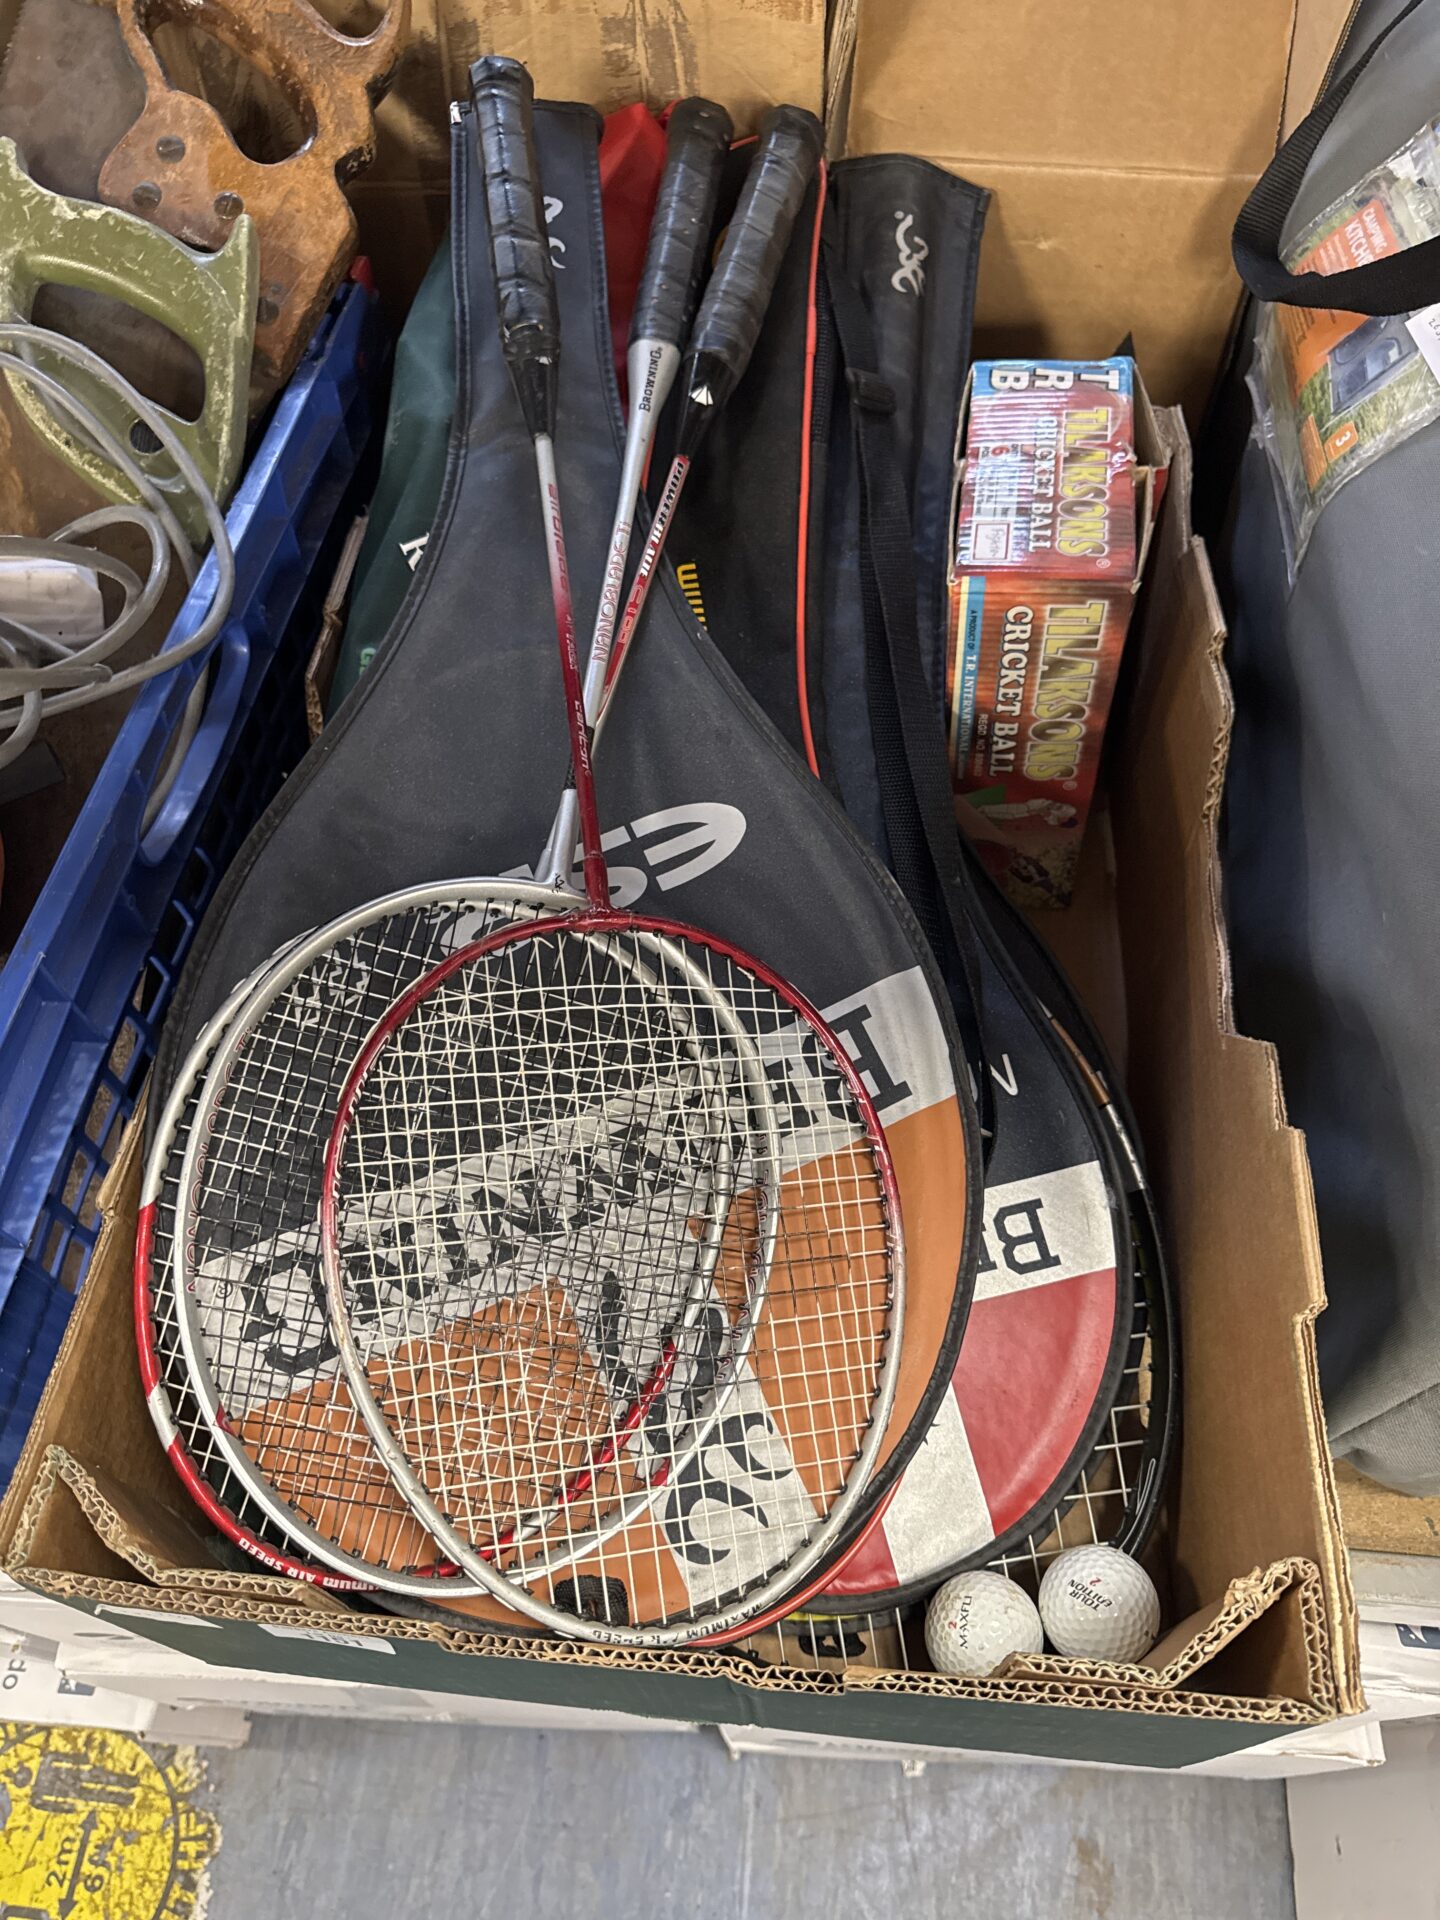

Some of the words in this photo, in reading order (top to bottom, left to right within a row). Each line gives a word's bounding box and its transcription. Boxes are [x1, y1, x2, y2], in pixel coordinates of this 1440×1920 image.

[1034, 416, 1058, 498] CRICKET
[1335, 431, 1351, 447] 3
[1057, 407, 1111, 557] TILAKSONS
[1028, 502, 1053, 553] BALL
[592, 541, 628, 664] NANOBLADE
[995, 605, 1034, 717] CRICKET
[957, 676, 976, 755] INTERNATIONAL
[1024, 599, 1109, 781] TILAKSONS
[988, 721, 1020, 777] BALL
[238, 1537, 284, 1572] SPEED
[287, 1567, 317, 1583] AIR
[1067, 1579, 1113, 1608] EDITION
[1069, 1589, 1101, 1612] TOUR
[1089, 1577, 1102, 1587] 2
[948, 1621, 957, 1630] 2
[959, 1595, 973, 1650] MAXFLI
